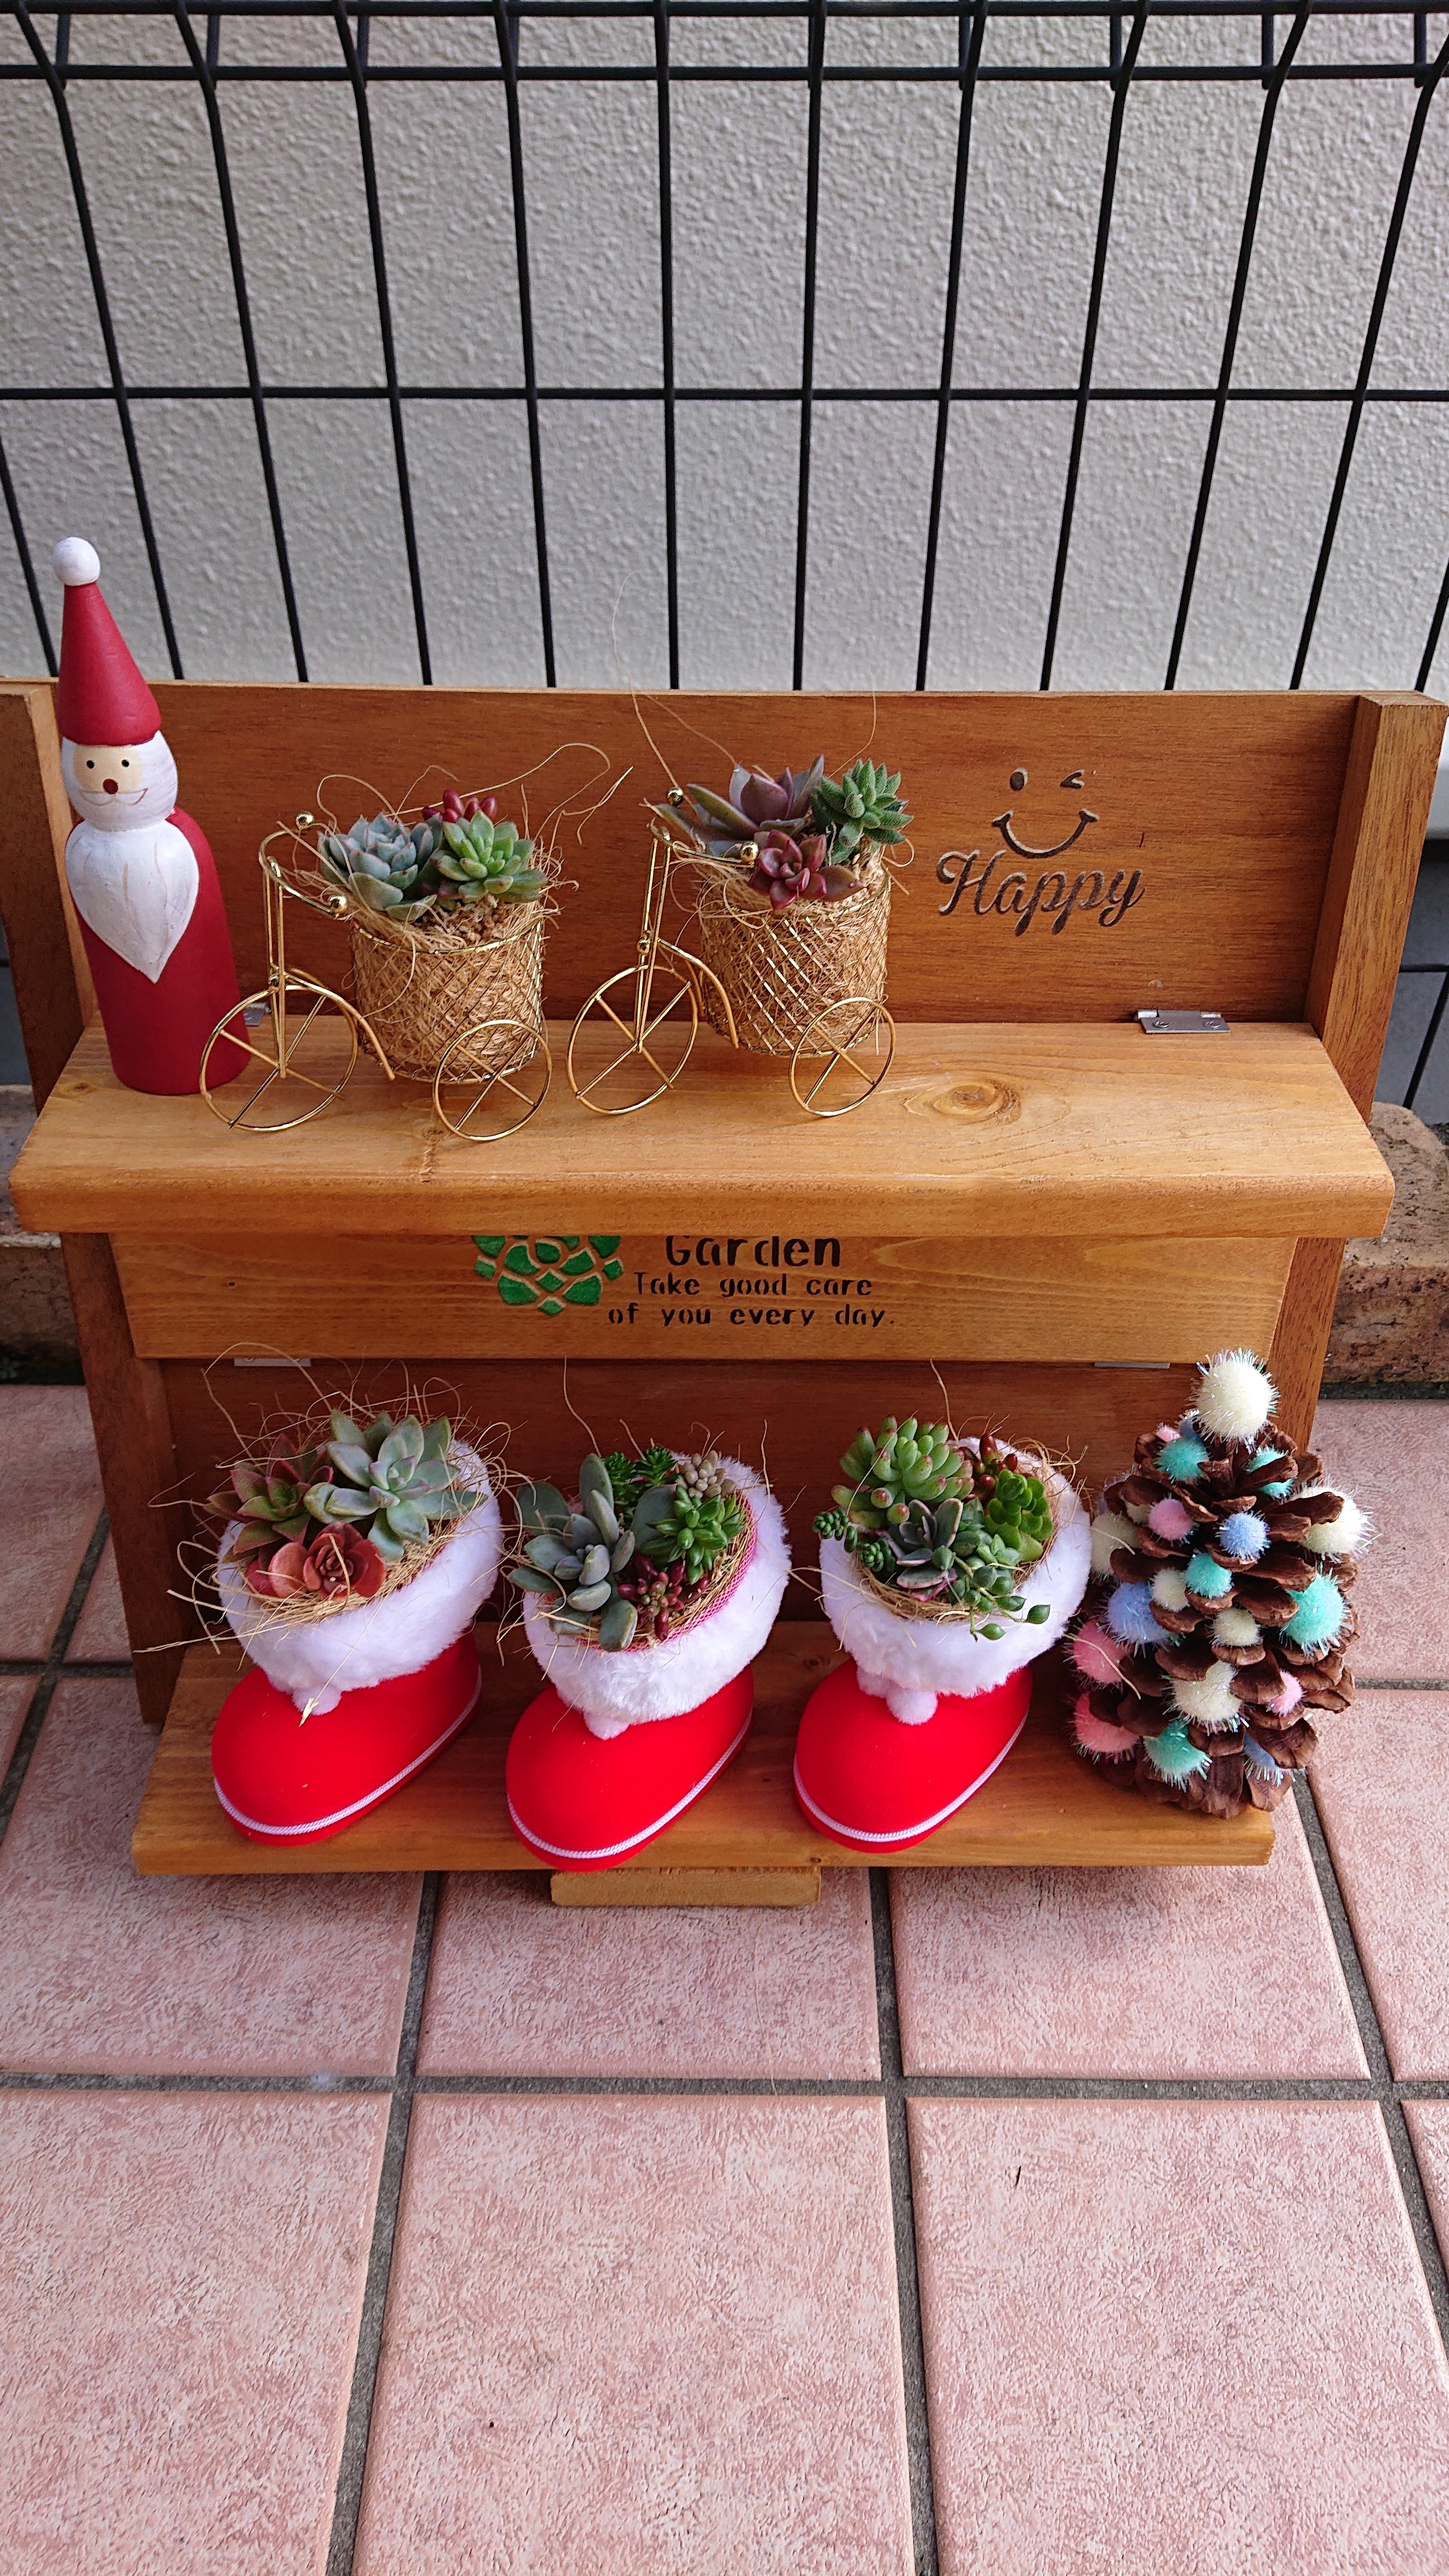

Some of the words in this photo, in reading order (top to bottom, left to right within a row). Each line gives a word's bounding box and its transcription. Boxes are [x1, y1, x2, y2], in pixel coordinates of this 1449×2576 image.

[937, 849, 1145, 936] Happy
[666, 1235, 841, 1266] Garden
[635, 1272, 700, 1295] Take
[720, 1273, 787, 1297] good
[807, 1277, 873, 1295] care
[608, 1303, 639, 1325] of
[661, 1308, 712, 1326] you
[730, 1308, 815, 1326] every
[835, 1304, 894, 1326] day.
